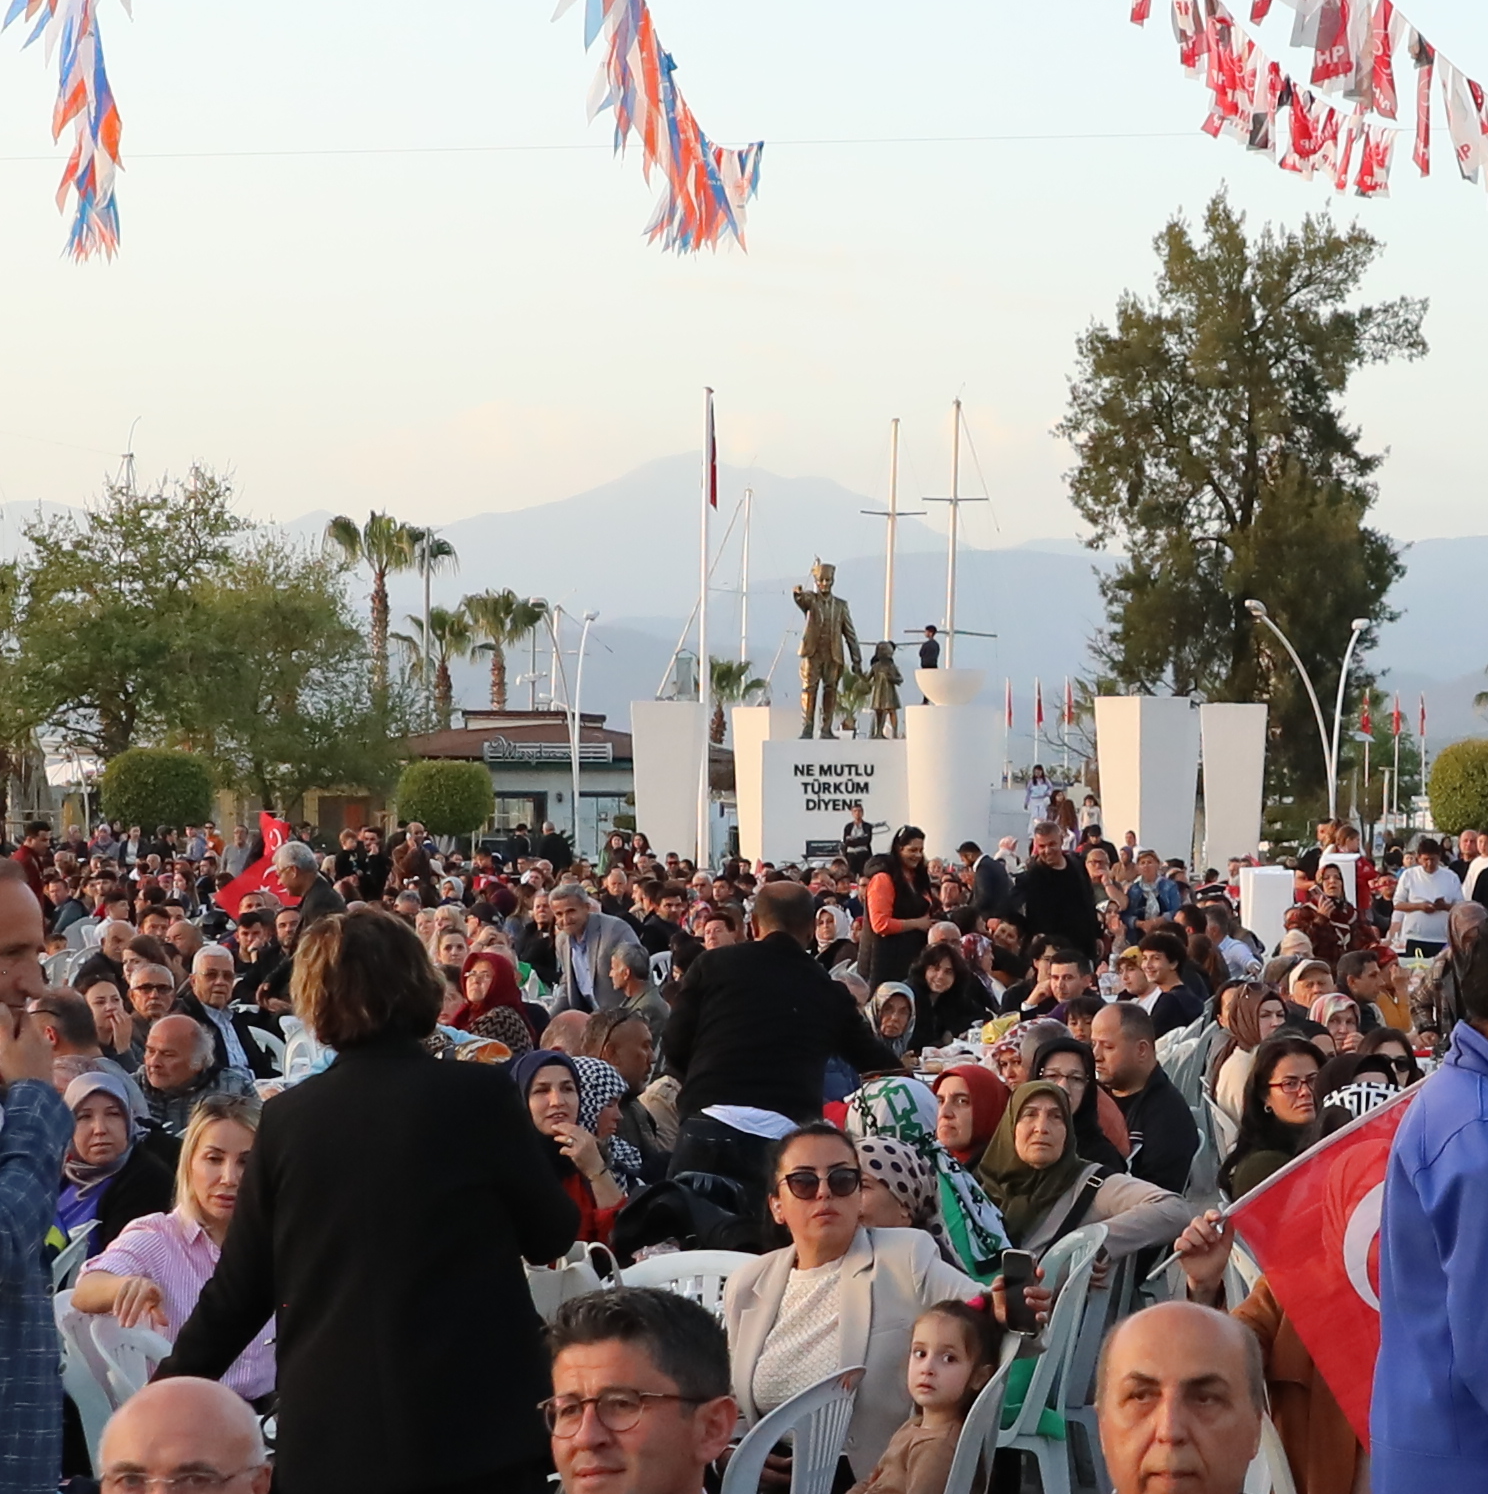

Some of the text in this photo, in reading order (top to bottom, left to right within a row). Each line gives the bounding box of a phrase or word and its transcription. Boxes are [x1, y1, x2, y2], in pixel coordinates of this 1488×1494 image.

[793, 764, 875, 777] NE MUTLU
[801, 778, 870, 795] TÜRKÜM
